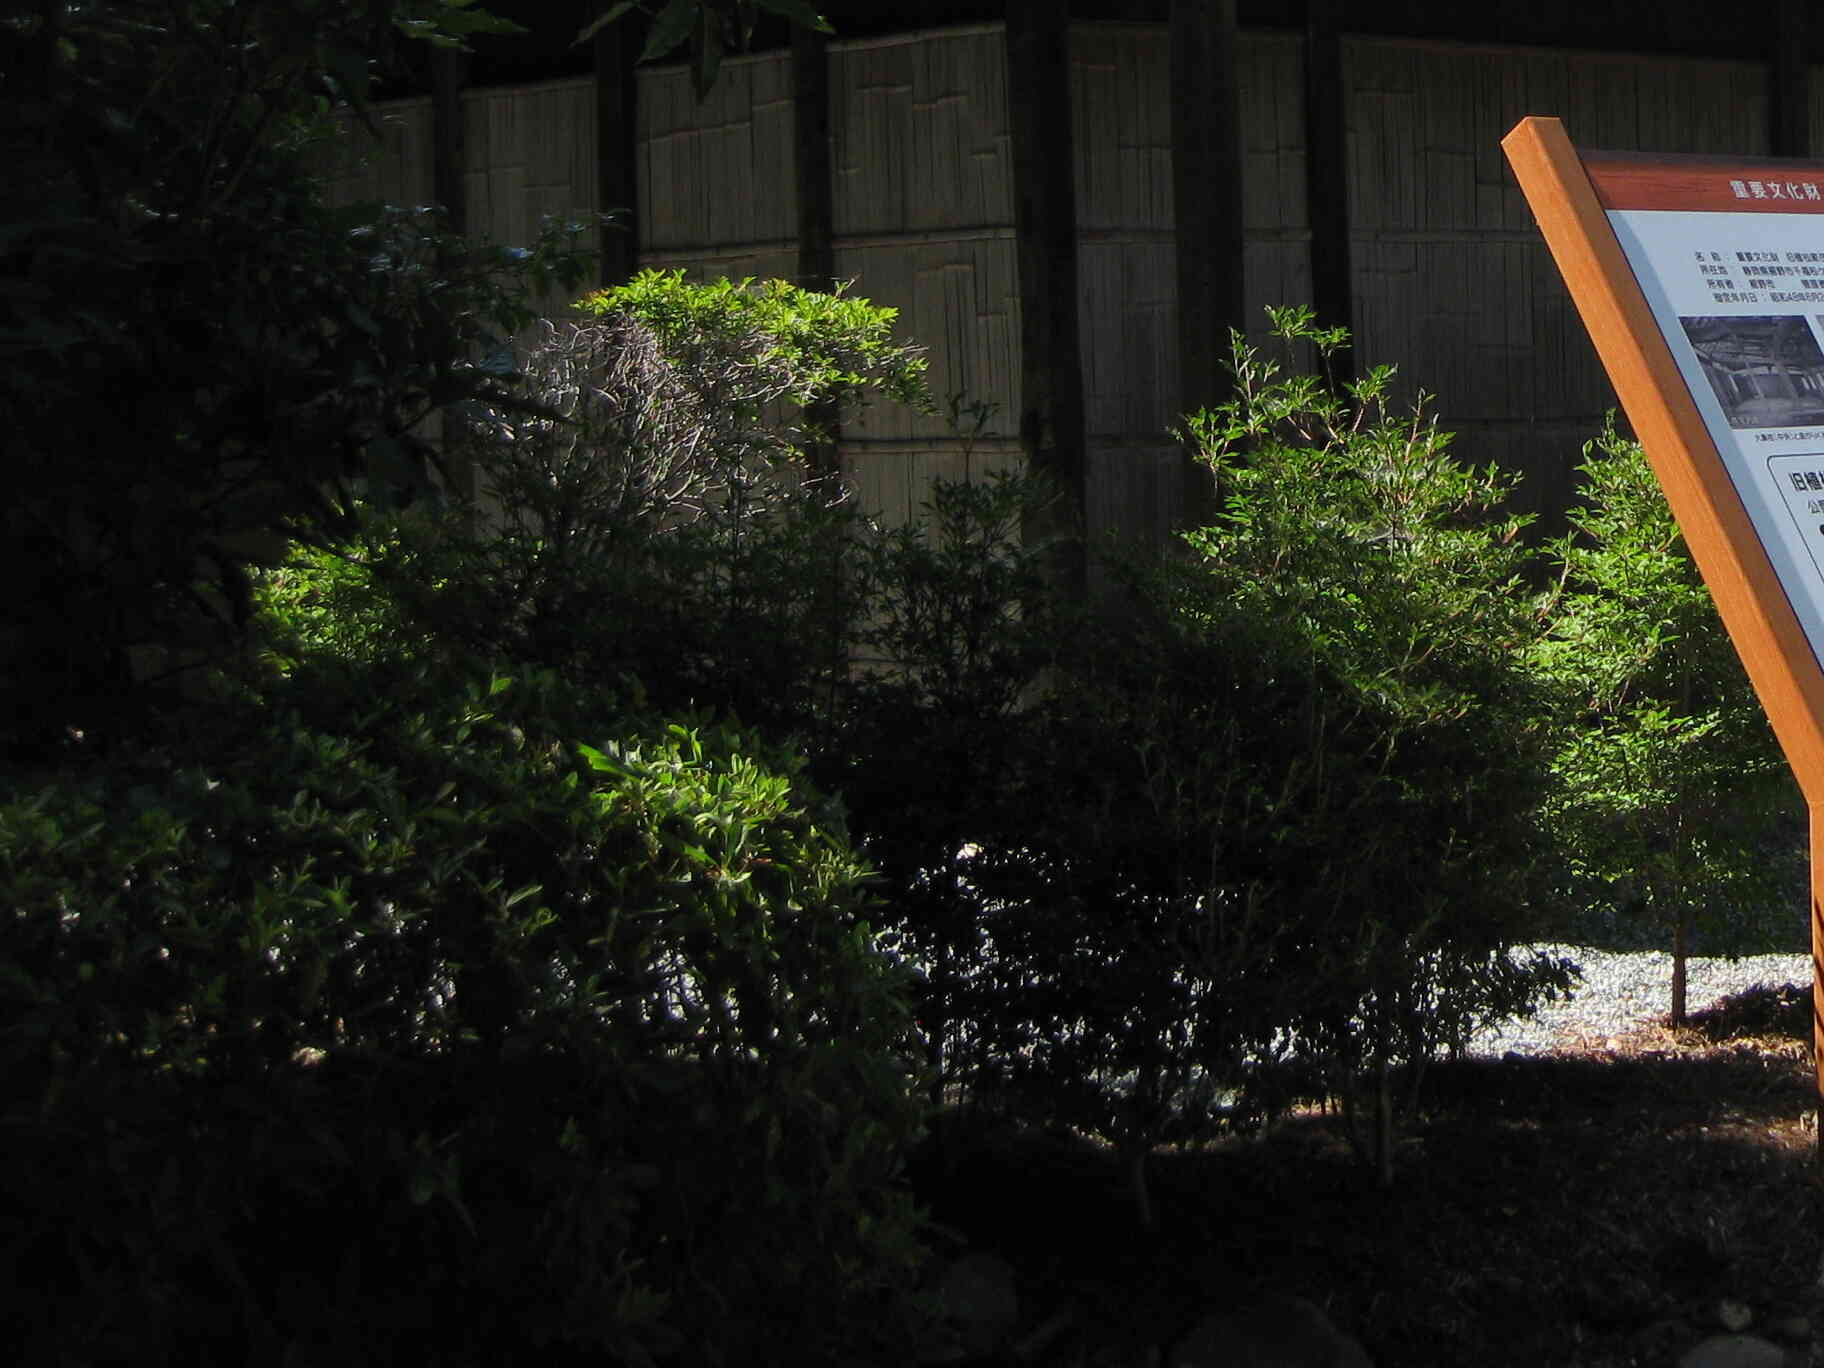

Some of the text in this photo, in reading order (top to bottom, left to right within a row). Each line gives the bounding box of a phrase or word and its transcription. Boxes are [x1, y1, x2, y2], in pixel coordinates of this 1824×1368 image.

[1729, 180, 1821, 200] 重要文化財
